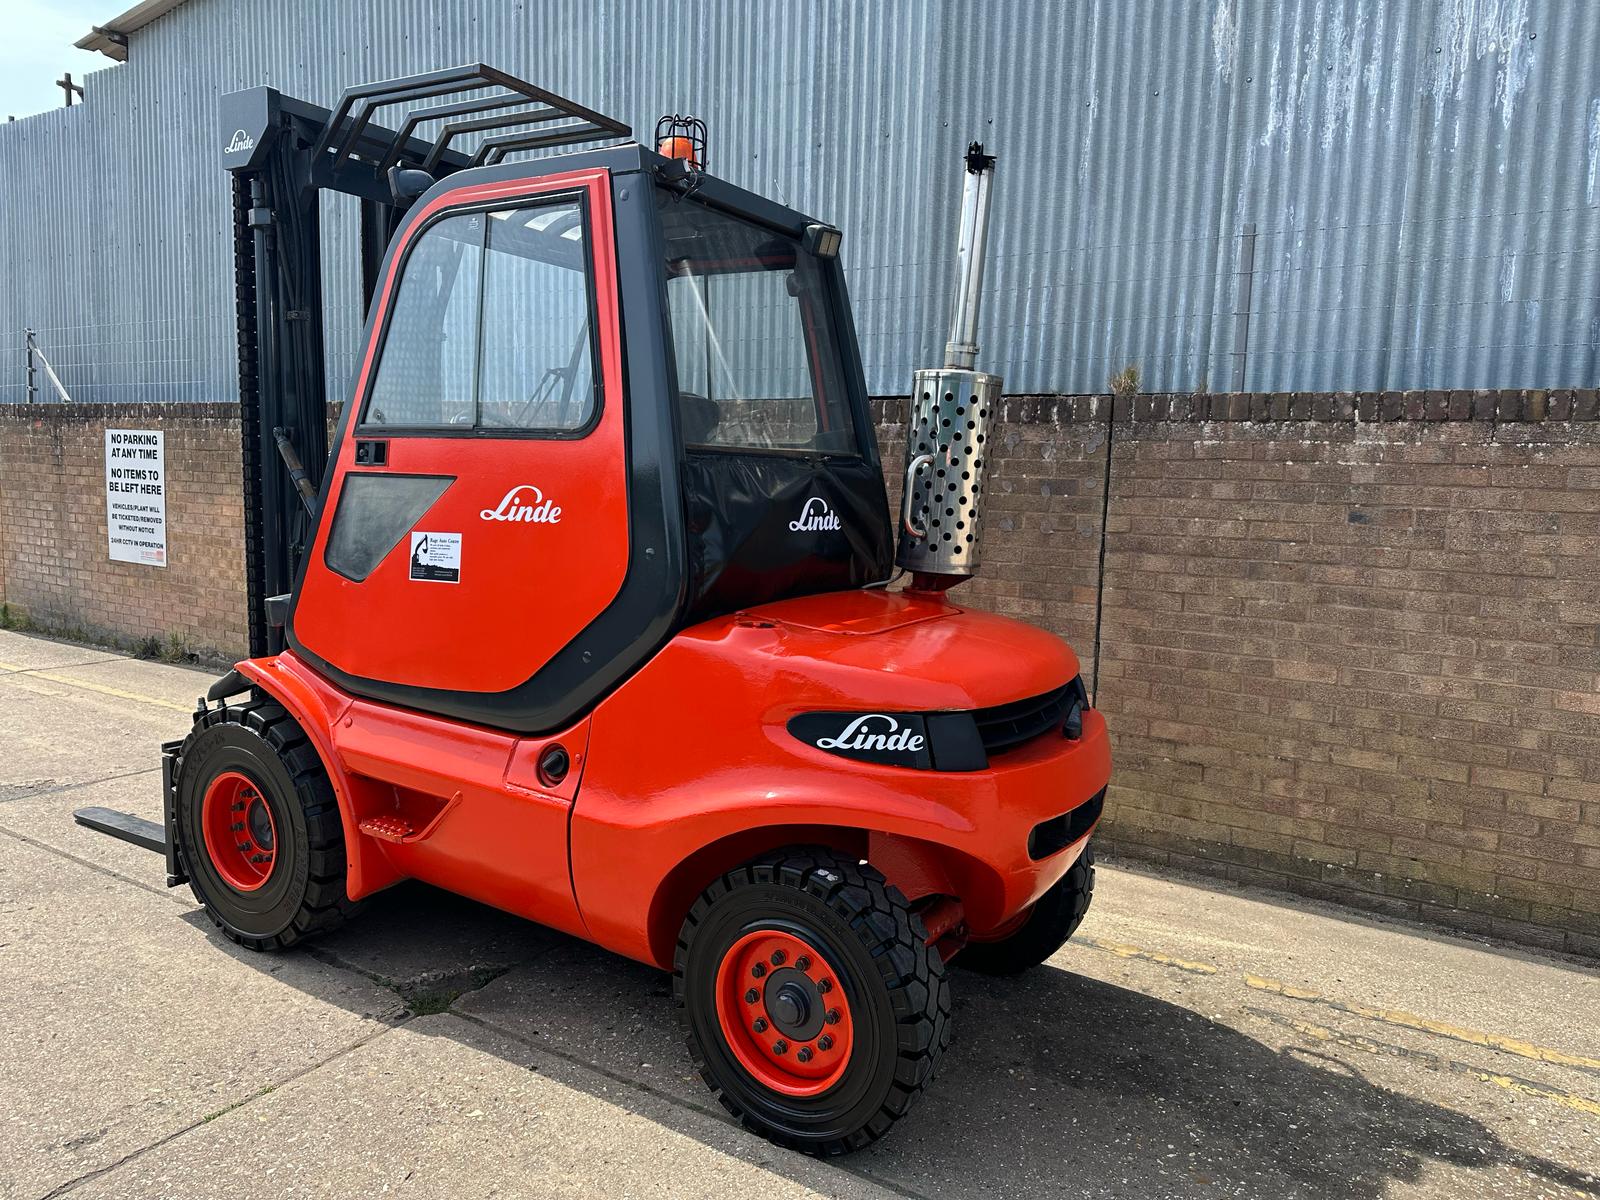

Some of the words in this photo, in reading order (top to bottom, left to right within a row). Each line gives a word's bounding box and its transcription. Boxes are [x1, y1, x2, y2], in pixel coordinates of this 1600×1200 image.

[224, 129, 254, 154] Linde
[111, 433, 122, 444] NO
[123, 434, 158, 445] PARKING
[111, 447, 121, 458] AT
[121, 448, 137, 459] ANY
[138, 449, 158, 460] TIME
[111, 468, 122, 478] NO
[123, 469, 147, 480] ITEMS
[147, 470, 159, 481] TO
[109, 481, 120, 492] BE
[120, 482, 139, 493] LEFT
[140, 484, 162, 495] HERE
[479, 484, 562, 524] Linde
[788, 496, 842, 532] Linde
[118, 525, 138, 533] WITHOUT
[139, 541, 164, 549] OPERATION
[816, 714, 924, 751] Linde
